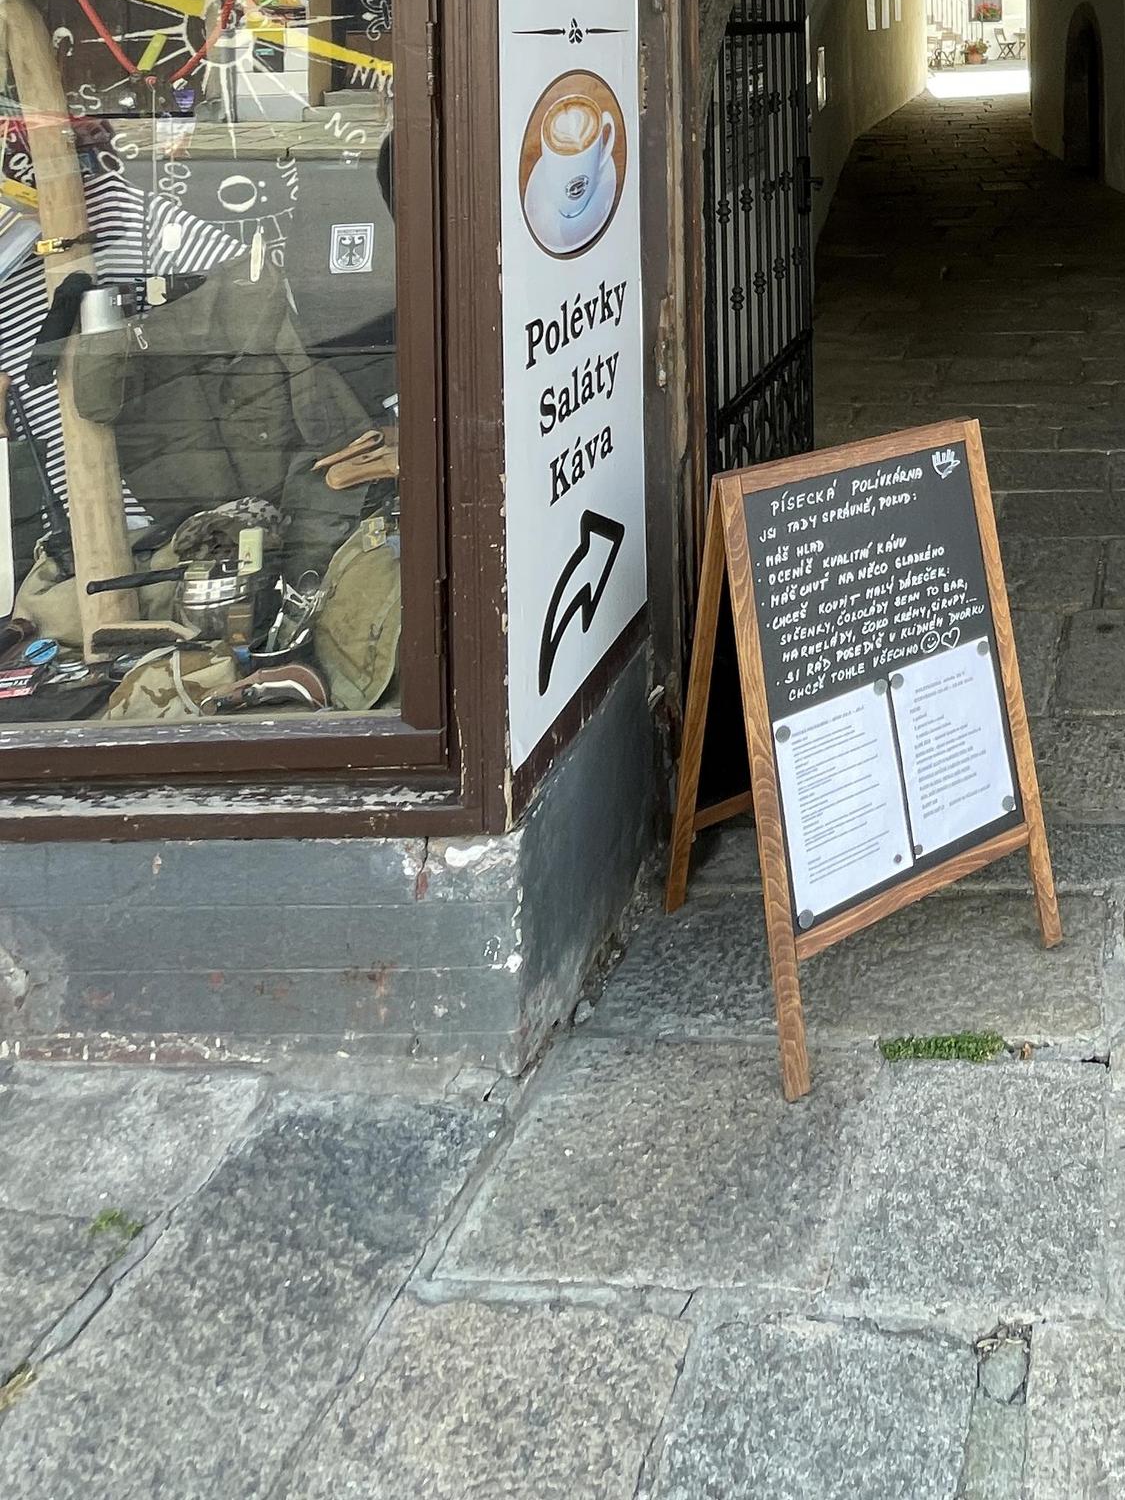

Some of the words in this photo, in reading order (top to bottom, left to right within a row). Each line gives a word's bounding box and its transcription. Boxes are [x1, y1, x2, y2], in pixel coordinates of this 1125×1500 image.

[525, 279, 628, 371] Polévky
[540, 351, 620, 437] Saláty
[549, 425, 613, 508] Káva
[770, 479, 837, 516] PÍSECKÁ
[852, 466, 923, 496] POLÍVKÁRNA
[787, 515, 817, 533] TADY
[766, 545, 789, 567] MÁŠ
[797, 540, 824, 557] HLAD
[822, 541, 873, 568] KVALITNÍ
[877, 533, 907, 555] KÁVU
[838, 571, 855, 585] NA
[858, 561, 888, 580] NĚCO
[895, 544, 945, 569] SLADKÉHO
[865, 575, 894, 599] MALÝ
[926, 586, 939, 597] TO
[784, 668, 800, 684] SI
[806, 655, 831, 676] RÁD
[889, 632, 896, 642] V
[948, 605, 984, 626] DVORKU
[831, 662, 865, 683] TOHLE
[873, 643, 918, 668] VŠECHNO
